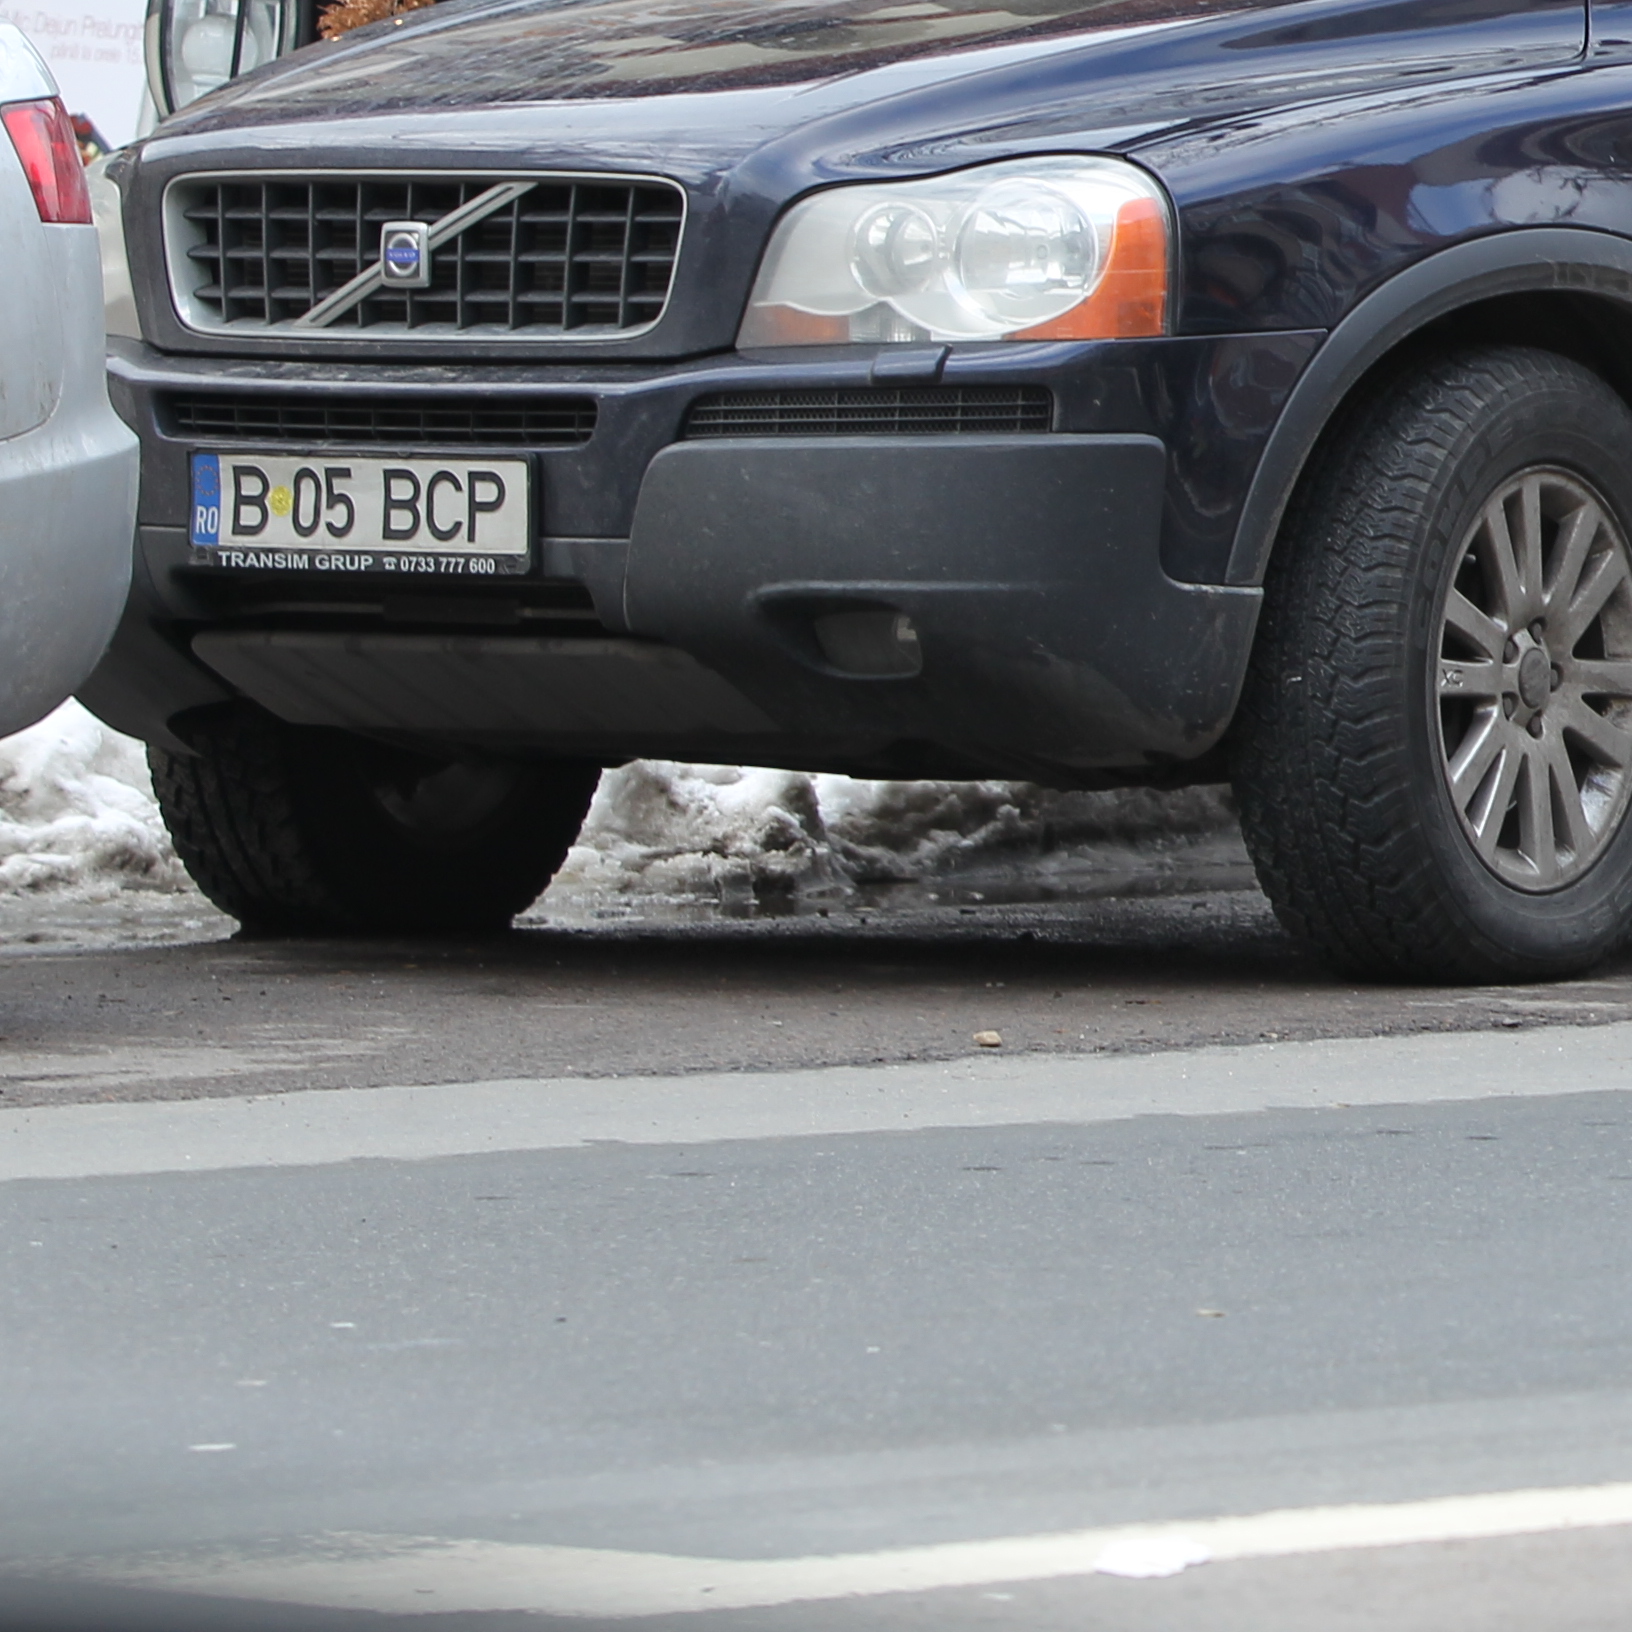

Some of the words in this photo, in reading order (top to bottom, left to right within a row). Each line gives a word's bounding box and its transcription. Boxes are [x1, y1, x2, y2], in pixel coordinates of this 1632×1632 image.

[232, 464, 270, 536] B
[293, 467, 355, 538] 05
[382, 468, 507, 543] BCP
[196, 506, 218, 535] RO
[218, 552, 309, 570] TRANSIM
[315, 555, 373, 572] GRUP
[400, 556, 435, 573] 0733
[439, 557, 465, 573] 777
[469, 559, 495, 574] 600
